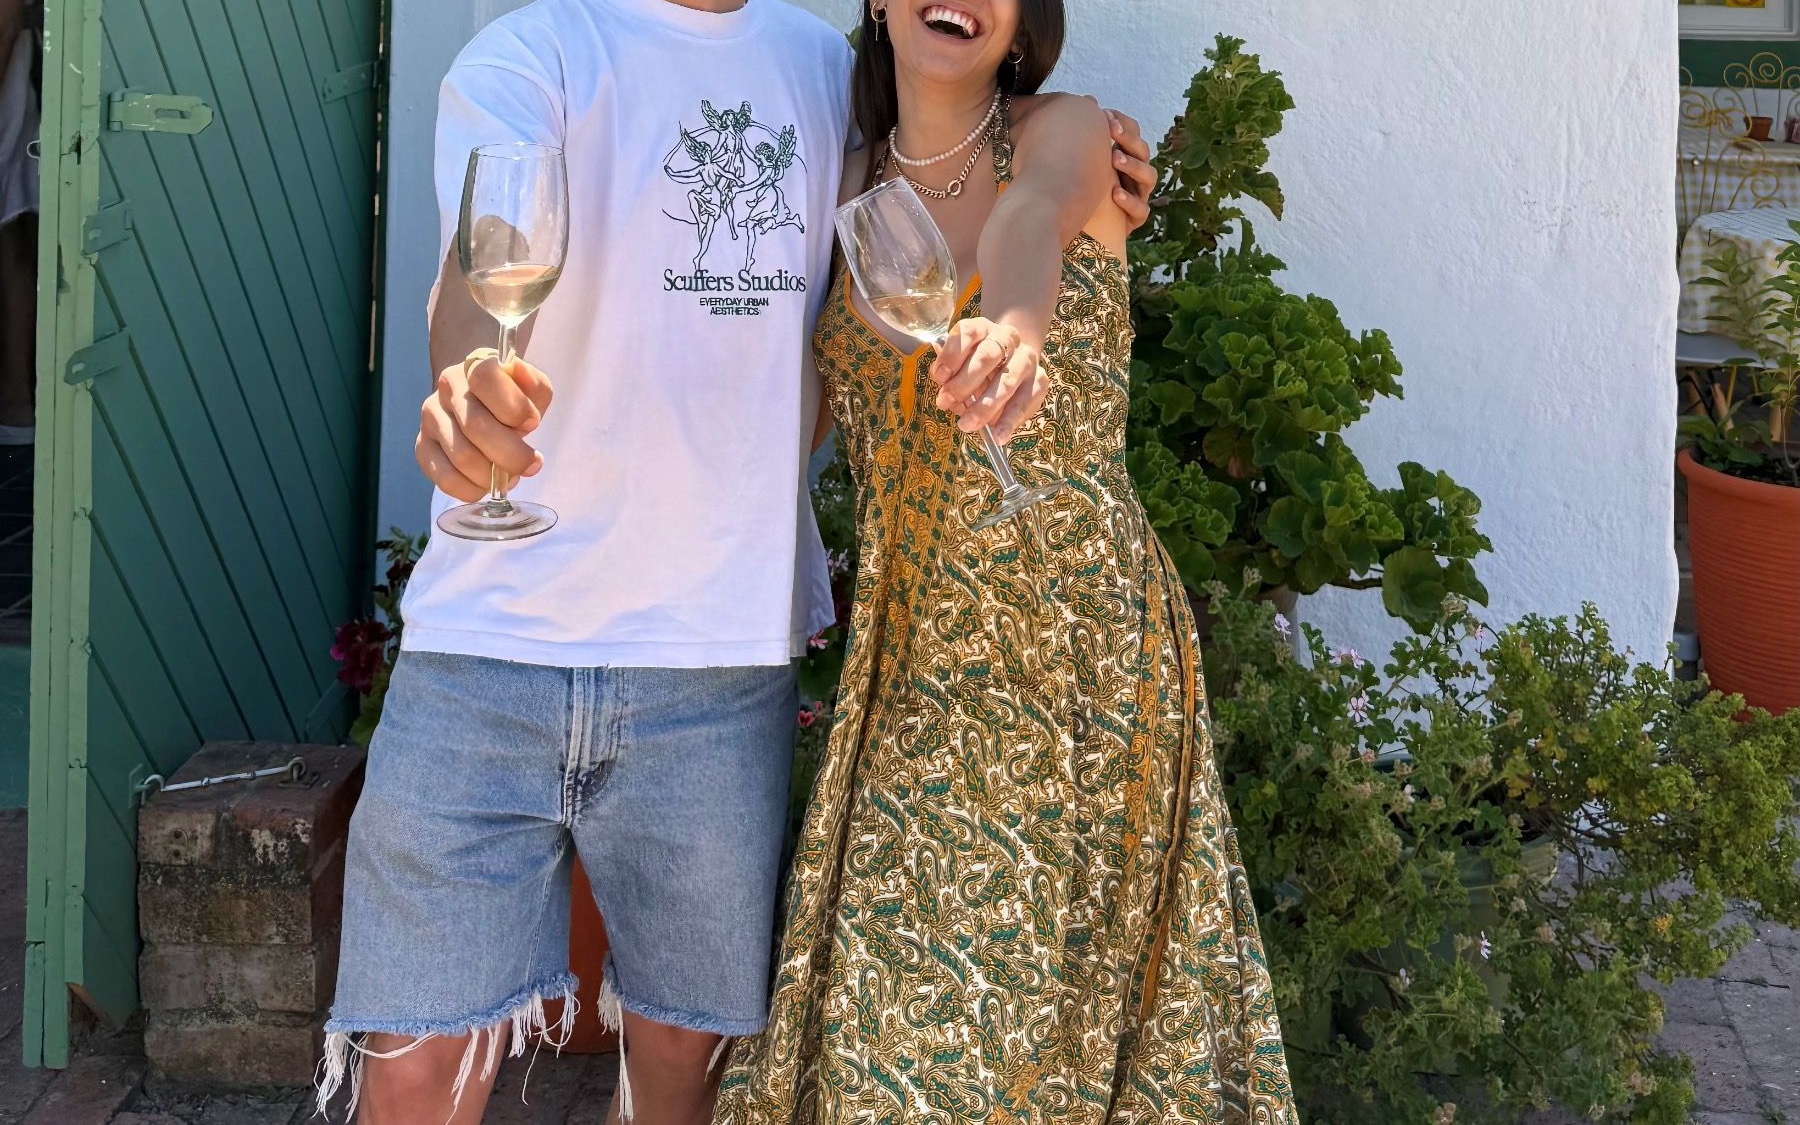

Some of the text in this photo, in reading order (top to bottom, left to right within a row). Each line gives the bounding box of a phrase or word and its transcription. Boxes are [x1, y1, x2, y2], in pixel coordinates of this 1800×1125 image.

[663, 268, 807, 293] Scuffers Studios
[699, 297, 770, 307] EVERYDAY URBAN
